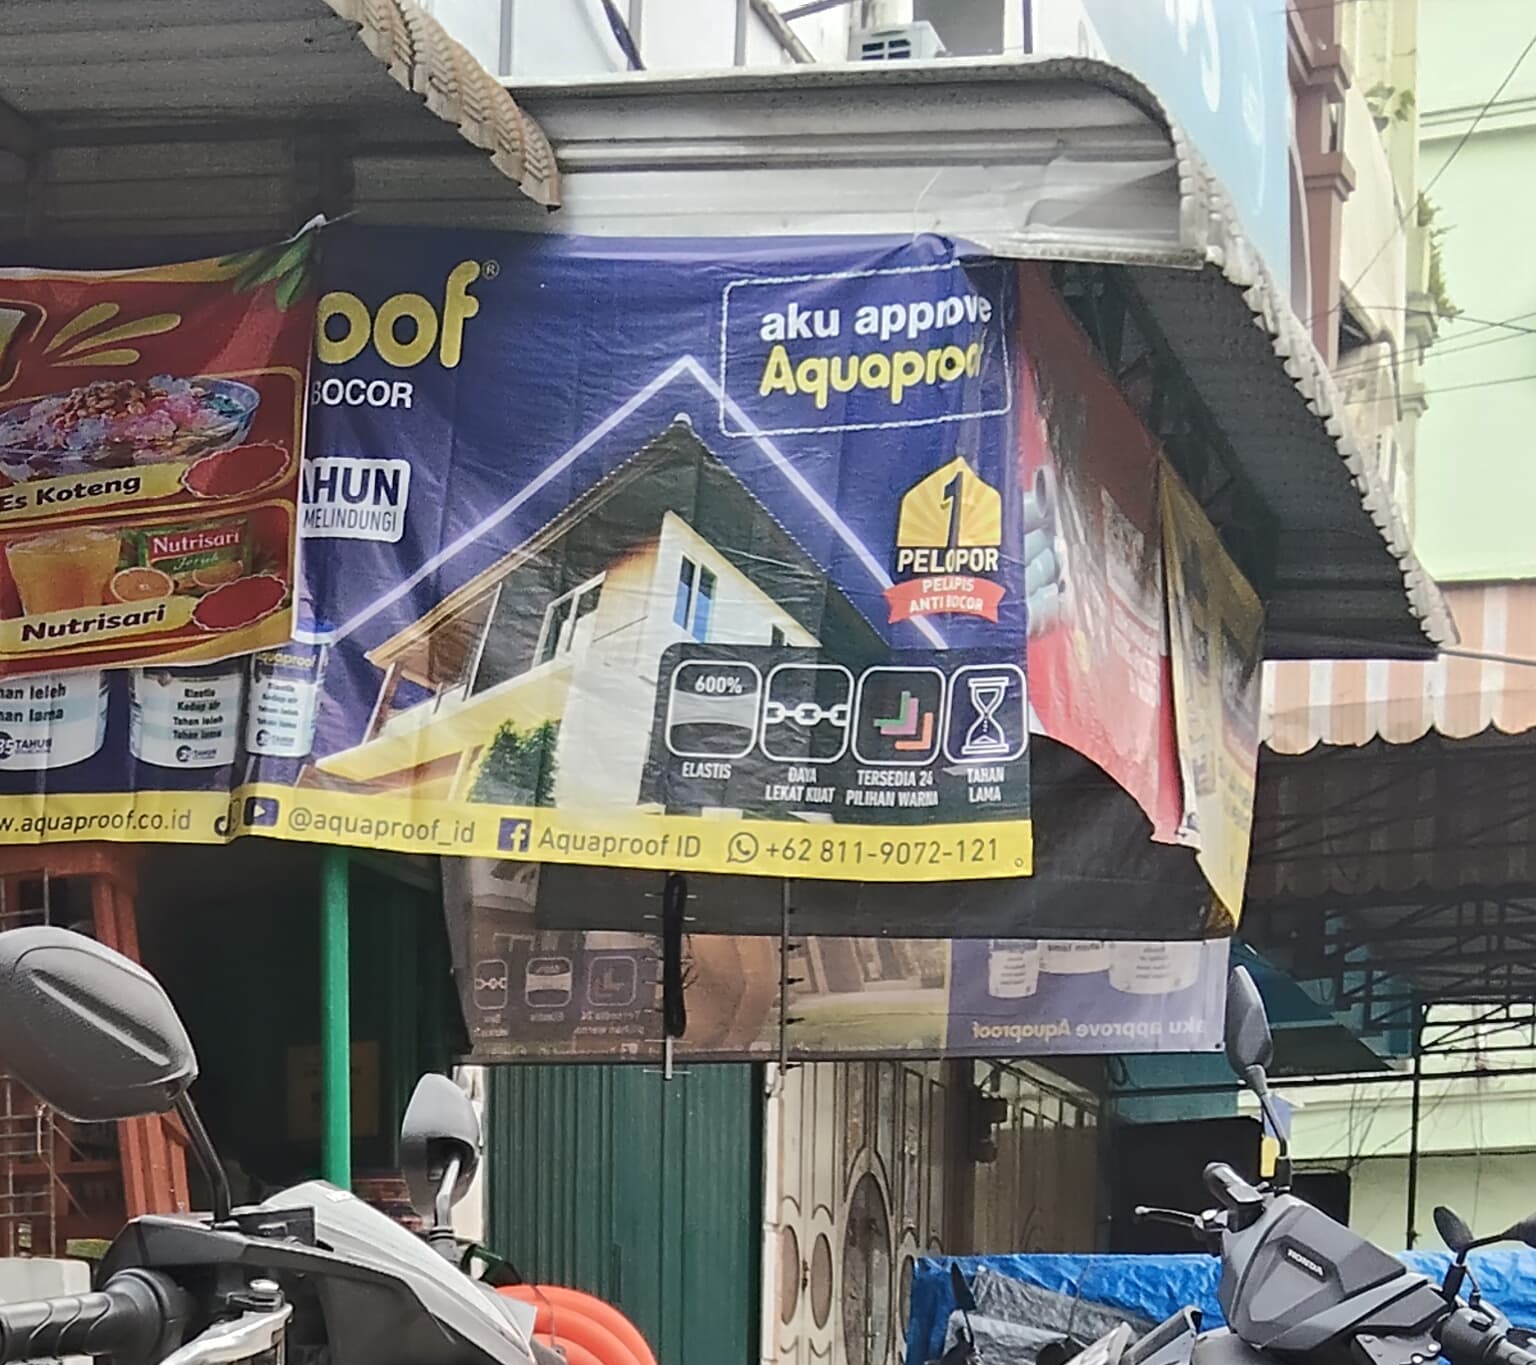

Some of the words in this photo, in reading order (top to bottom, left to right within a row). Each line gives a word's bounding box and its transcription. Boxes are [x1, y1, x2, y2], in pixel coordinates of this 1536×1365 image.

[760, 302, 840, 341] aku
[36, 476, 141, 505] Koteng
[303, 508, 397, 532] MELINDUNGI
[153, 530, 240, 554] Nutrisari
[897, 548, 999, 573] PELOPOR
[21, 605, 166, 642] Nutrisari
[695, 675, 743, 694] 600%
[682, 762, 731, 780] ELASTIS
[856, 770, 916, 786] TERSEDIA
[967, 767, 1005, 783] TAHAN
[765, 785, 804, 802] LEKAT
[845, 790, 895, 807] PILIHAN
[968, 786, 1001, 803] LAMA
[288, 807, 475, 846] @aquaproof_id
[537, 827, 669, 857] Aquaproof
[676, 835, 701, 858] ID
[766, 838, 811, 860] +62
[820, 838, 998, 864] 811-9072-121
[1288, 1248, 1324, 1276] HONDA
